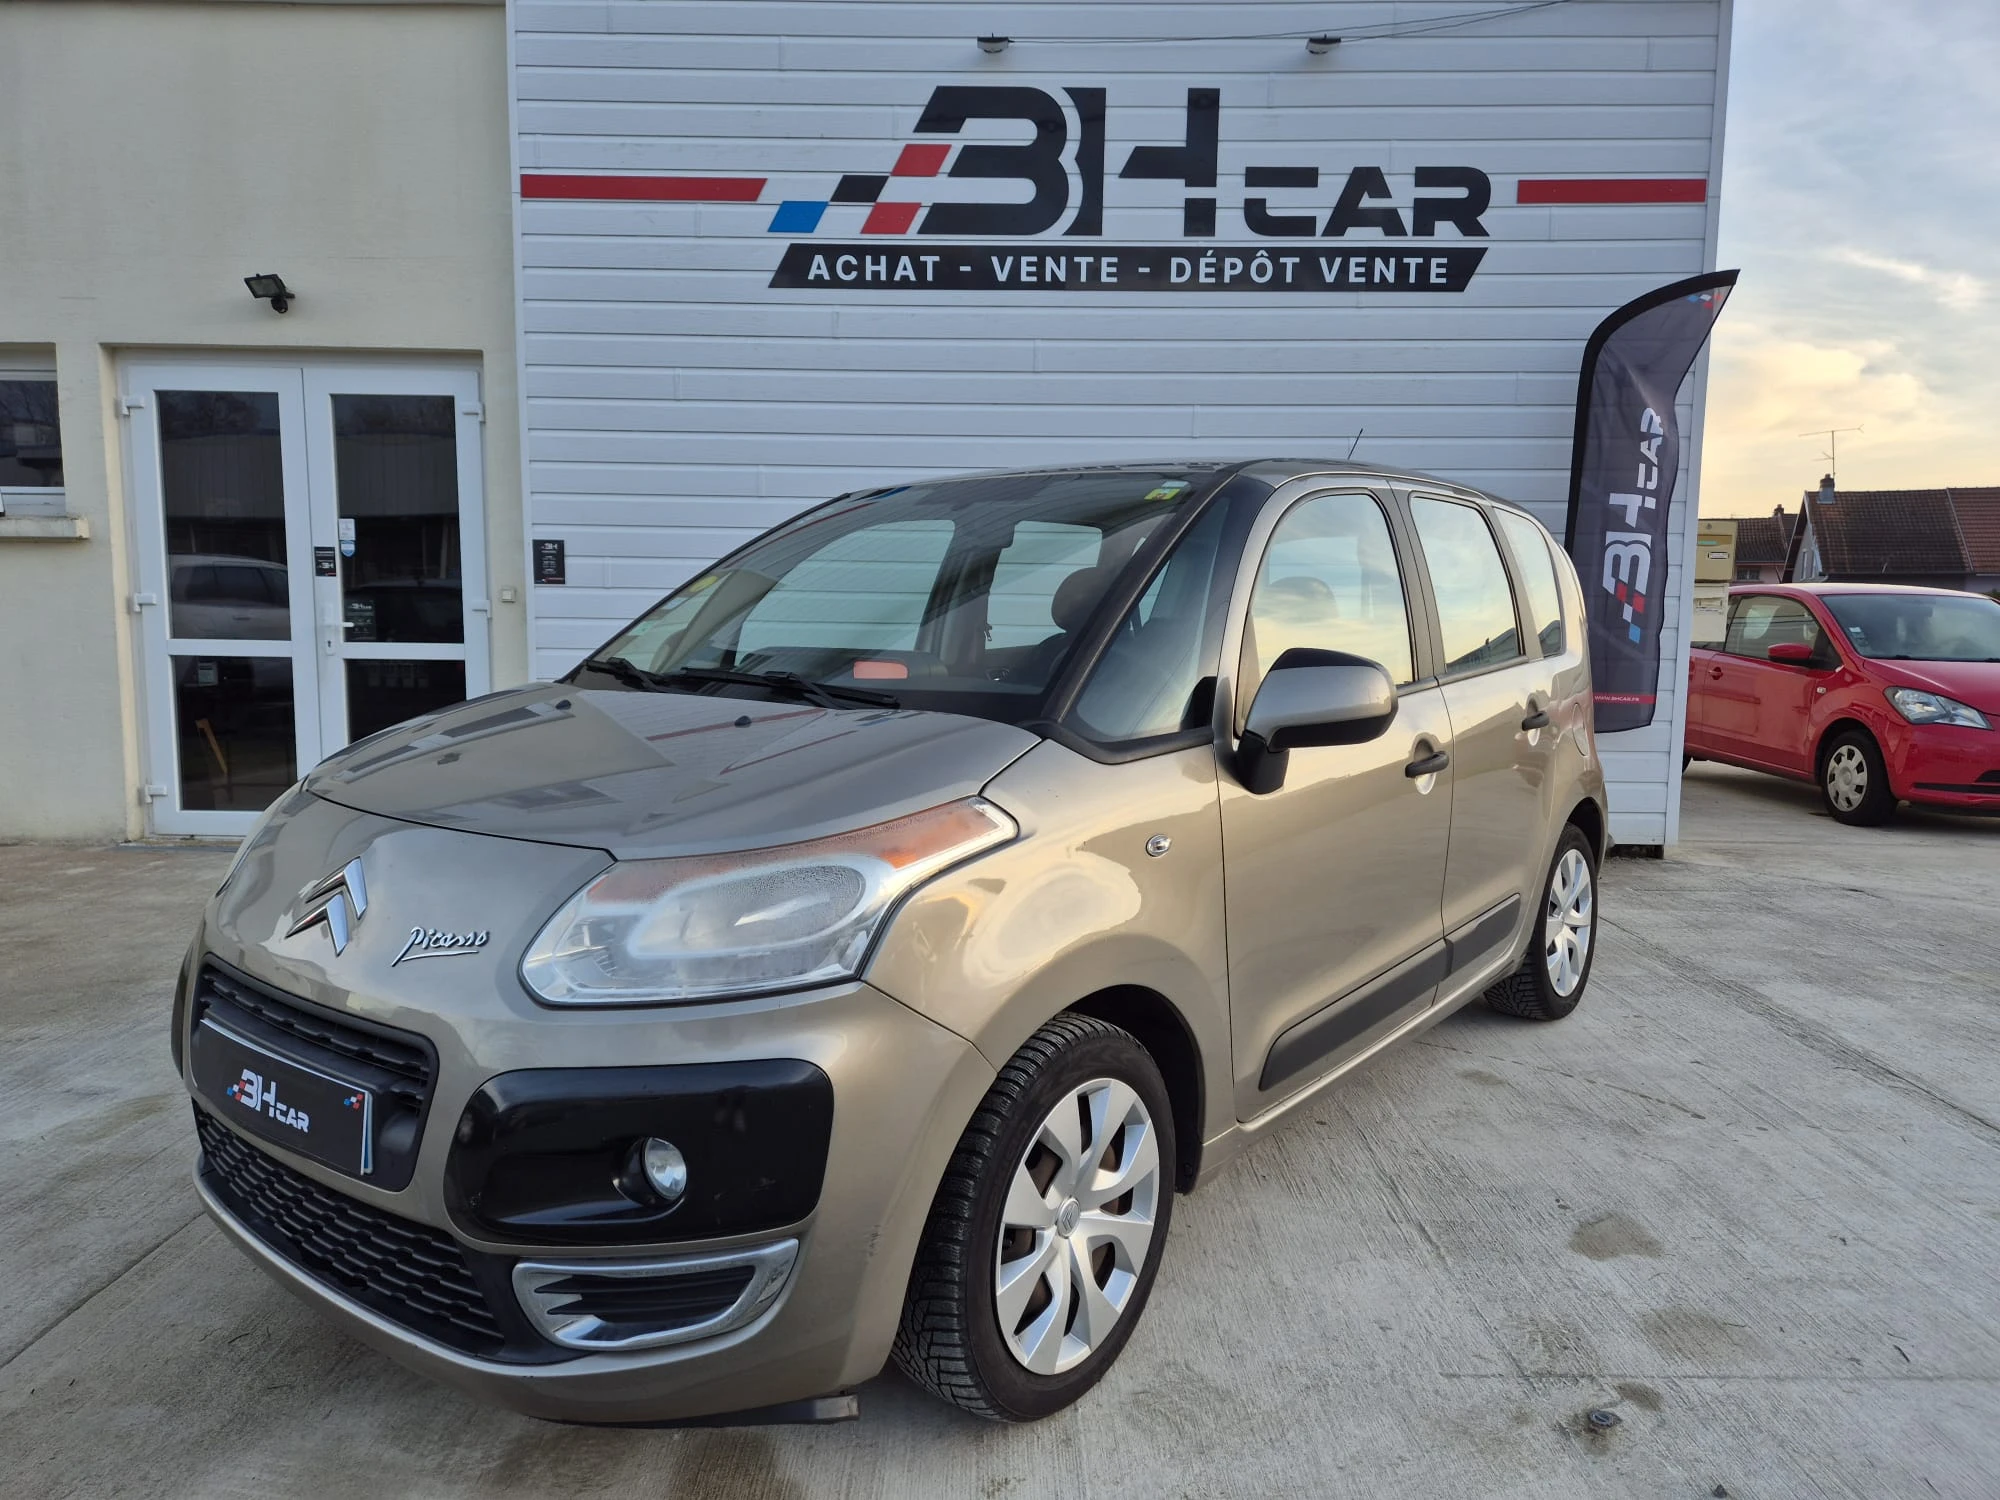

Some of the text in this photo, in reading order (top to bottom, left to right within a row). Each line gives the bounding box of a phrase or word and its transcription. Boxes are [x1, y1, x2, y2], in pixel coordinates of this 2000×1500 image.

[806, 254, 942, 282] ACHAT
[990, 255, 1119, 283] VENTE
[1170, 249, 1301, 284] DÉPÔT
[1319, 257, 1449, 284] VENTE
[391, 926, 490, 967] Picasso
